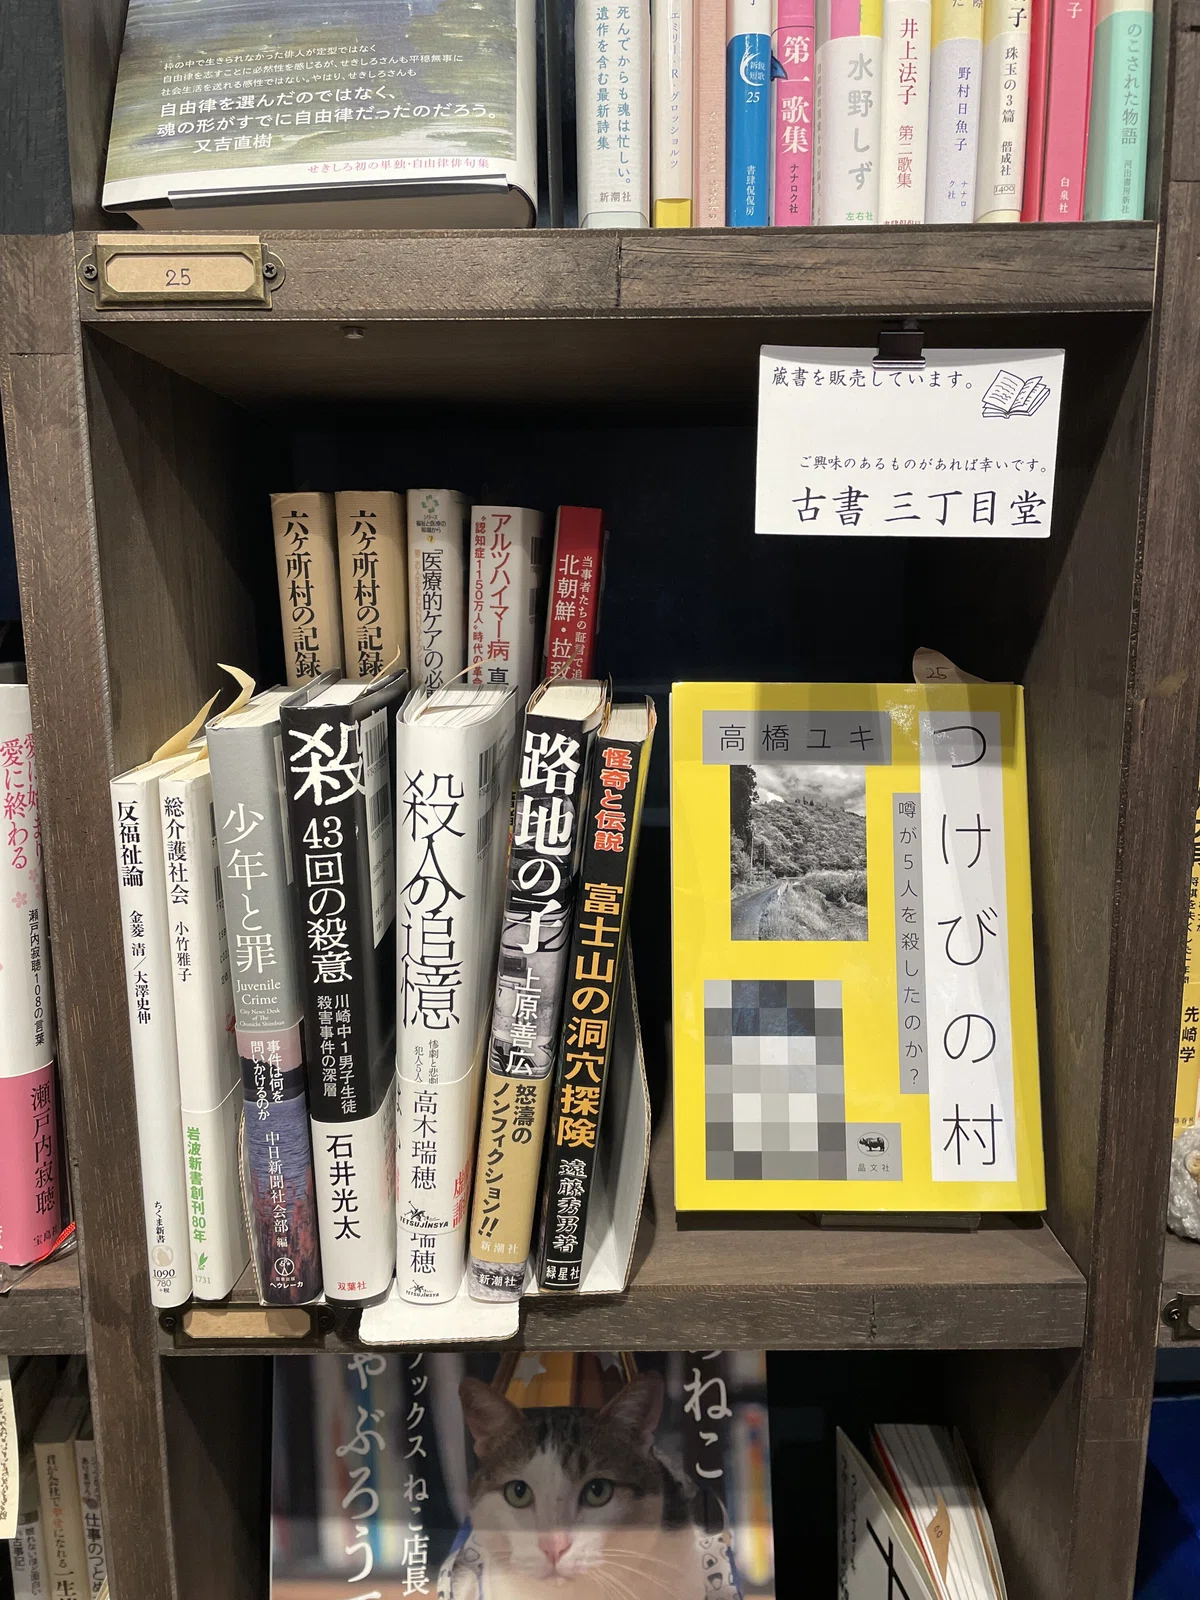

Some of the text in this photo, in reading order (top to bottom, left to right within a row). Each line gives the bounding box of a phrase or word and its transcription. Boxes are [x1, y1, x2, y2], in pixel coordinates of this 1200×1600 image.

[161, 68, 417, 97] 社会生活を送れる感性ではない。やはり、せきしろさんも
[164, 45, 376, 71] 枠の中で生きられなかった俳人が定型ではなく
[595, 7, 610, 150] 遺作を含む最新詩集
[897, 17, 919, 106] 井上法子
[1001, 46, 1019, 124] 珠玉の3篇
[1121, 23, 1142, 145] のこされた物語
[157, 103, 496, 138] 魂の形がすでに自由律だったのだろう。
[160, 85, 396, 118] 自由律を選んだのではなく、
[616, 6, 631, 185] 死んでからも魂は忙しい。
[746, 91, 760, 103] 25
[781, 35, 810, 154] 第一歌集
[847, 53, 873, 191] 水野しず
[955, 66, 971, 152] 野村日魚子
[193, 133, 272, 154] 又吉直樹
[896, 125, 914, 189] 第二歌集
[1000, 141, 1013, 176] 偕成社
[599, 191, 631, 203] 新潮社
[788, 163, 799, 214] ナナロク社
[846, 211, 873, 221] 左右社
[1059, 176, 1070, 214] 白泉社
[1121, 159, 1132, 215] 河出書房新社
[165, 268, 191, 287] 25
[771, 366, 972, 390] 蔵書を販売しています。
[799, 455, 1047, 473] ご興味のあるものがあれば幸いです。
[925, 666, 948, 680] 25
[288, 721, 366, 806] 殺
[719, 723, 874, 752] 高橋ユキ
[0, 737, 28, 870] 愛に終わる
[593, 747, 633, 853] 怪奇と伝説
[117, 800, 145, 888] 反福祉論
[164, 796, 190, 905] 総介護社会
[514, 729, 581, 955] 路地の子
[222, 802, 278, 974] 少年と罪
[302, 815, 353, 984] 43回の殺意
[400, 769, 466, 1030] 殺人の追憶
[174, 921, 192, 982] 小竹雅子
[933, 725, 1003, 1166] つけびの村
[28, 909, 45, 1047] 瀬戸内寂聴108の言葉
[236, 978, 281, 993] Juvenile
[241, 993, 278, 1005] Crime
[316, 995, 336, 1097] 殺害事件の深層
[505, 967, 542, 1076] 上原善広
[556, 882, 624, 1149] 富士山の洞穴探険
[1179, 1005, 1199, 1063] 先崎学
[250, 1040, 270, 1121] 問いかけるのか
[266, 1039, 284, 1104] 事件は何を
[334, 994, 357, 1114] 川崎中1男子生徒
[414, 1045, 424, 1083] 犯人5人
[411, 1089, 438, 1191] 高木瑞穂
[511, 1083, 537, 1145] 怒濤の
[30, 1080, 56, 1215] 瀬戸内寂聴
[857, 1162, 890, 1173] 晶文社
[186, 1126, 207, 1243] 岩波新書創刊80年
[325, 1133, 361, 1241] 石井光太
[154, 1200, 165, 1243] ちくま新書
[480, 1240, 519, 1254] 新潮社
[153, 1268, 176, 1279] 1090
[156, 1279, 172, 1287] 780
[195, 1274, 211, 1284] 1731
[337, 1280, 367, 1292] 双葉社
[479, 1273, 518, 1287] 新潮社
[546, 1265, 580, 1281] 緑星社
